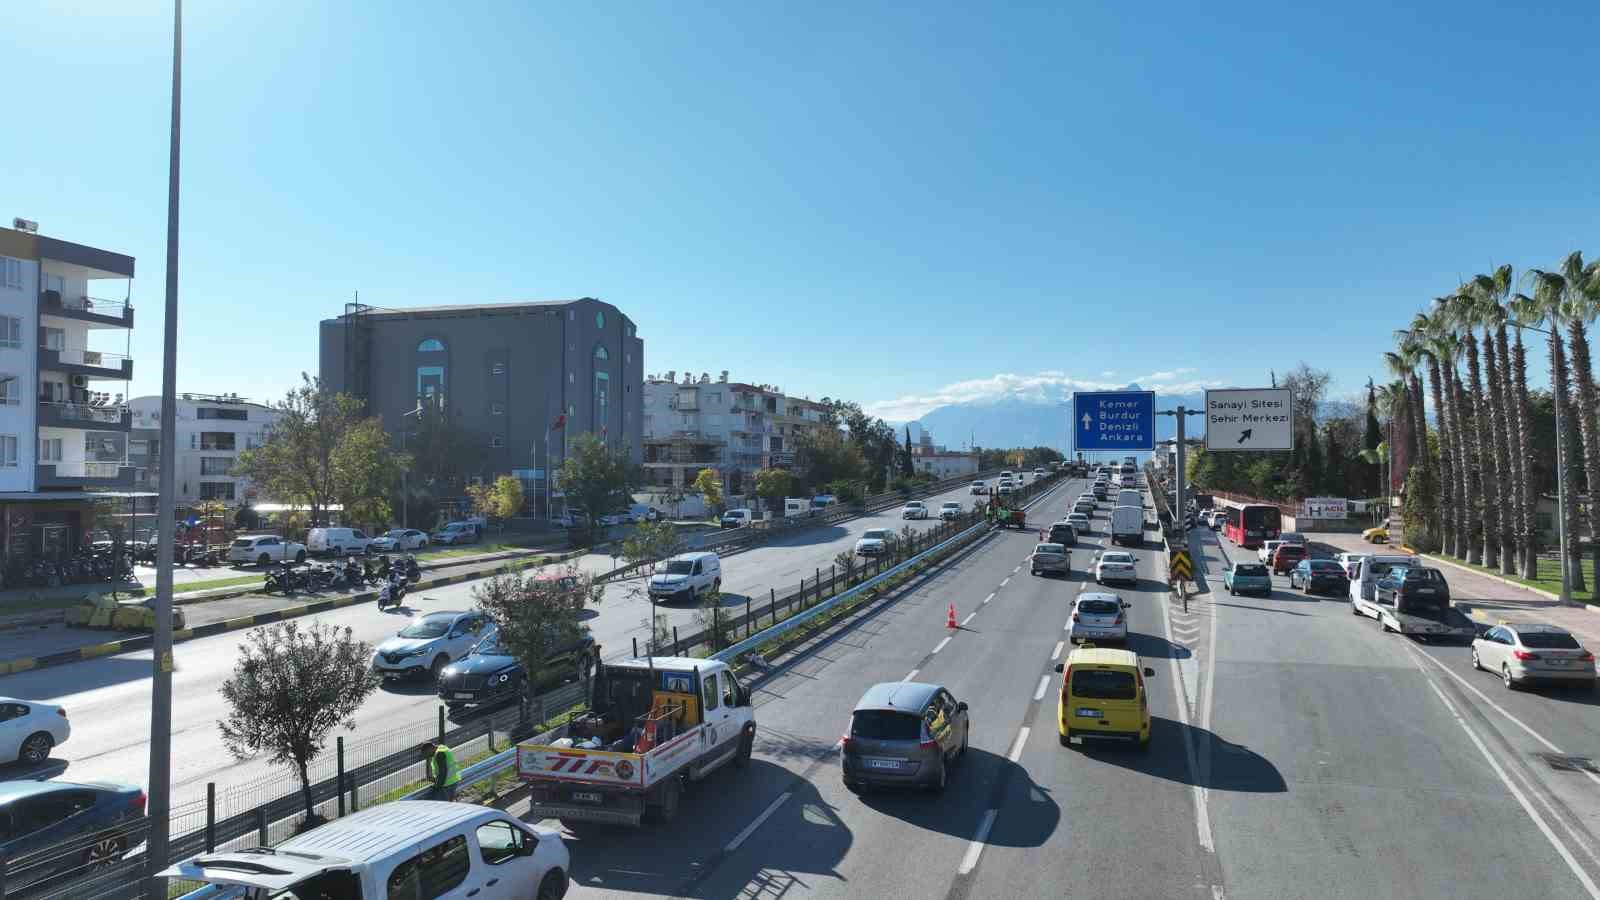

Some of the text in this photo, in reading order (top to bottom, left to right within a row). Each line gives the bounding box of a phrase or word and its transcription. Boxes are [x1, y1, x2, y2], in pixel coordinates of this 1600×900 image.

[1099, 400, 1138, 408] Kemer
[1209, 399, 1283, 411] Sanayi Sitesi
[1099, 411, 1141, 419] Burdur
[1242, 413, 1289, 423] Merkezi
[1099, 422, 1139, 431] Denizli
[1100, 432, 1143, 441] Ankara
